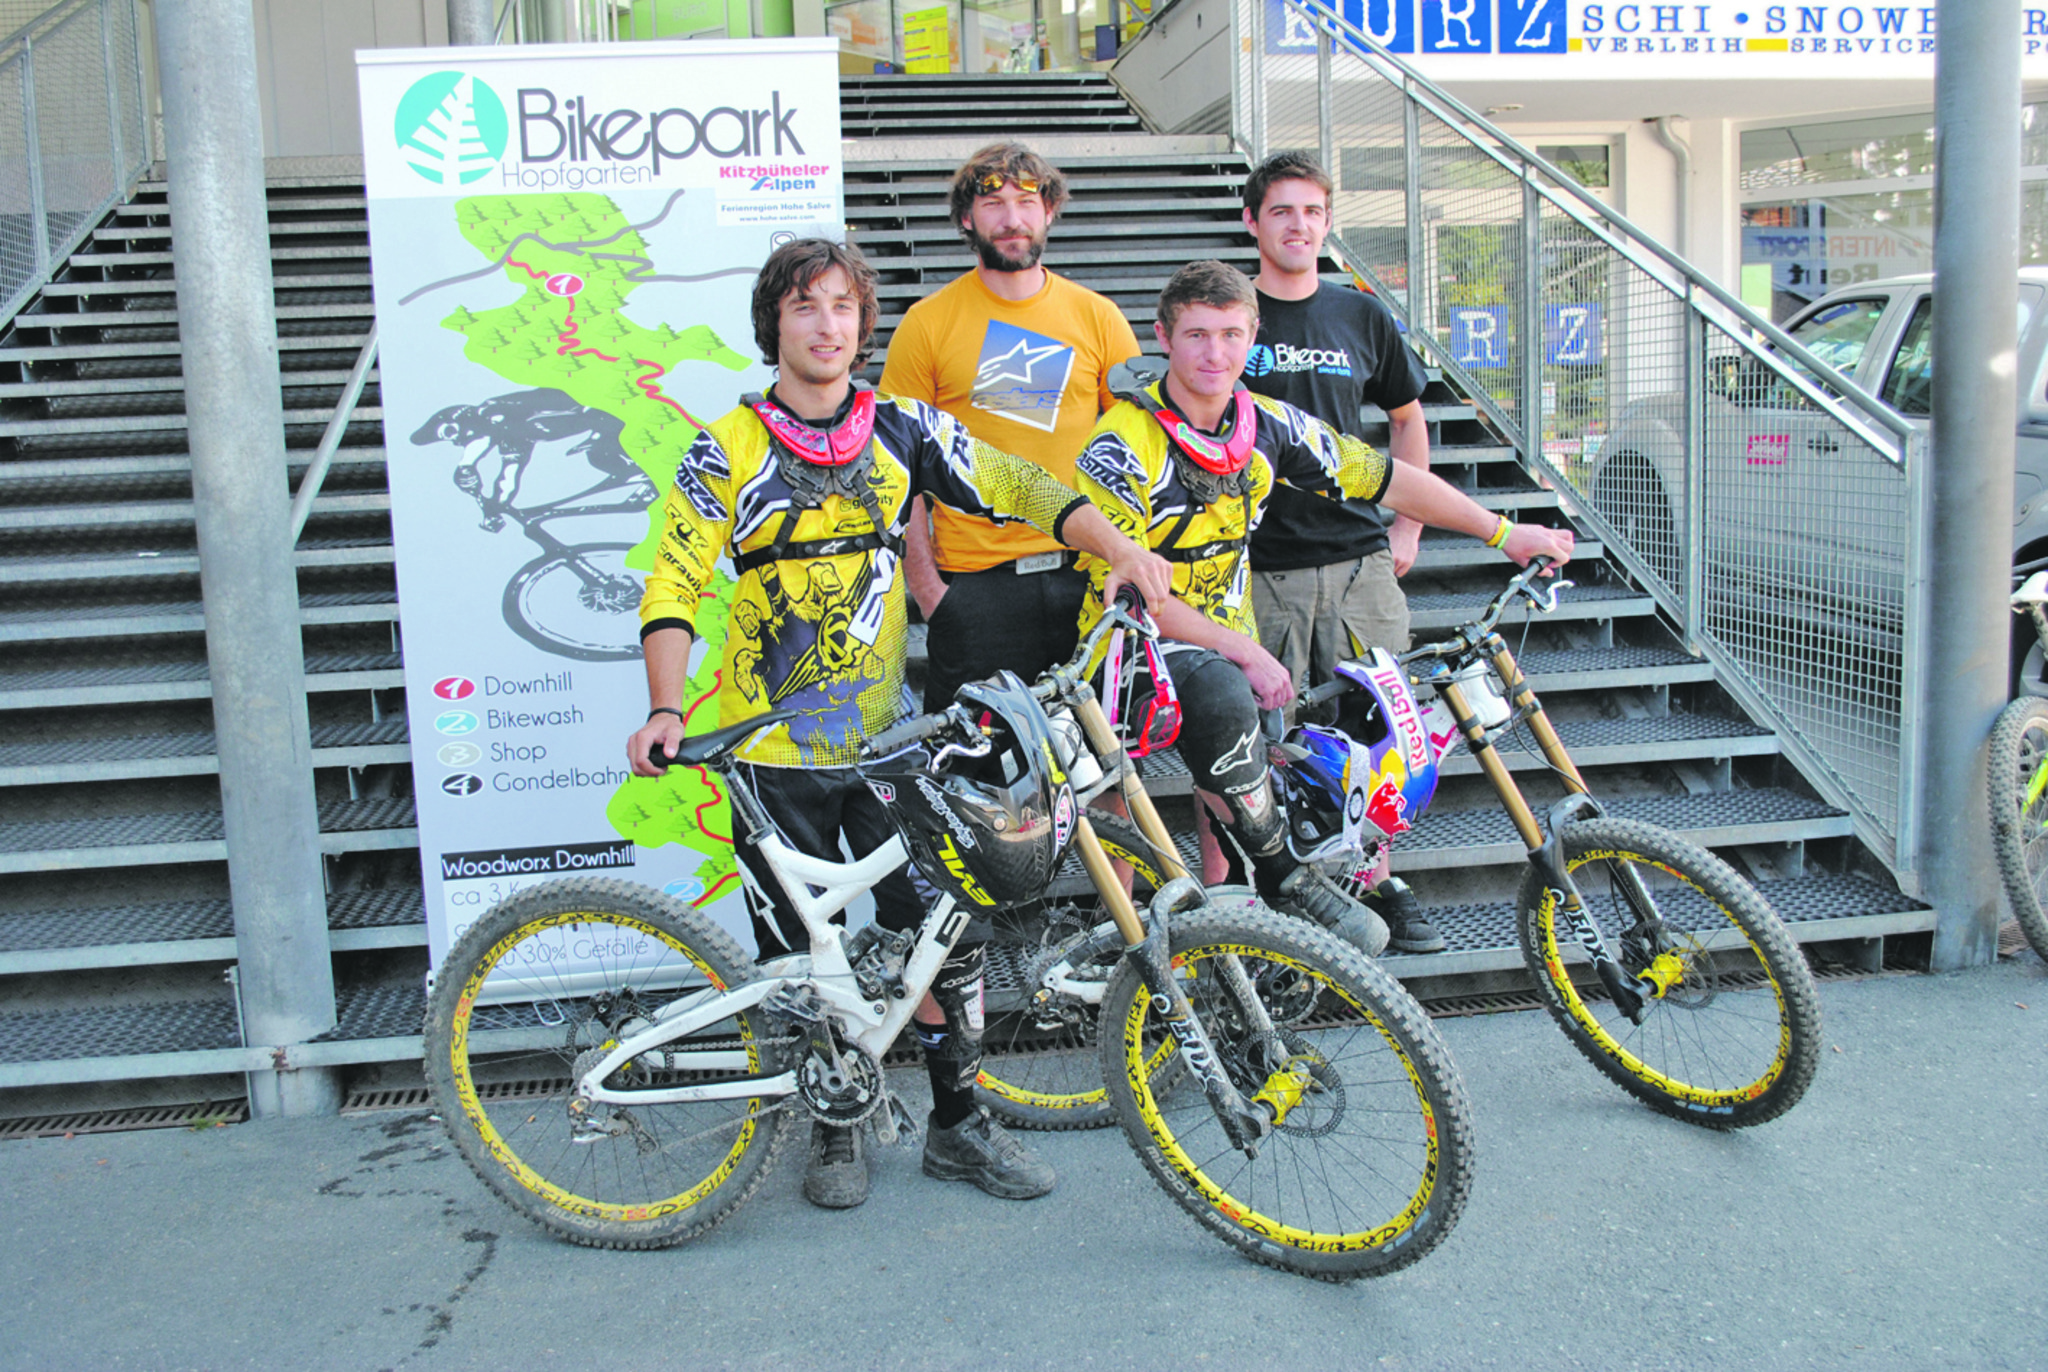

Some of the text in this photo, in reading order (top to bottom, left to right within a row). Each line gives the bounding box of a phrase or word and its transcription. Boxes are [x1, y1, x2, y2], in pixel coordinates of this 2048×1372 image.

[1582, 4, 1711, 33] SCHI
[1584, 37, 1743, 52] VERLEIH
[1790, 38, 1935, 54] SERVICE
[517, 88, 806, 175] Bikepark
[502, 162, 653, 190] Hopfgarten
[719, 164, 830, 181] Kitzbüheler
[806, 202, 831, 210] Salve
[1274, 343, 1351, 369] Bikepark
[444, 671, 572, 699] 1 Downhill
[487, 704, 584, 730] Bikewash
[490, 742, 547, 763] Shop
[1398, 716, 1428, 770] Red
[444, 765, 631, 796] 4 Gondelbahn
[442, 845, 636, 878] Woodworx Downhill
[451, 890, 481, 906] ca
[488, 882, 502, 903] 3
[524, 943, 567, 964] 30%
[573, 936, 649, 960] Gefälle
[1146, 1145, 1198, 1201] MUDDY
[1205, 1210, 1259, 1245] MARY
